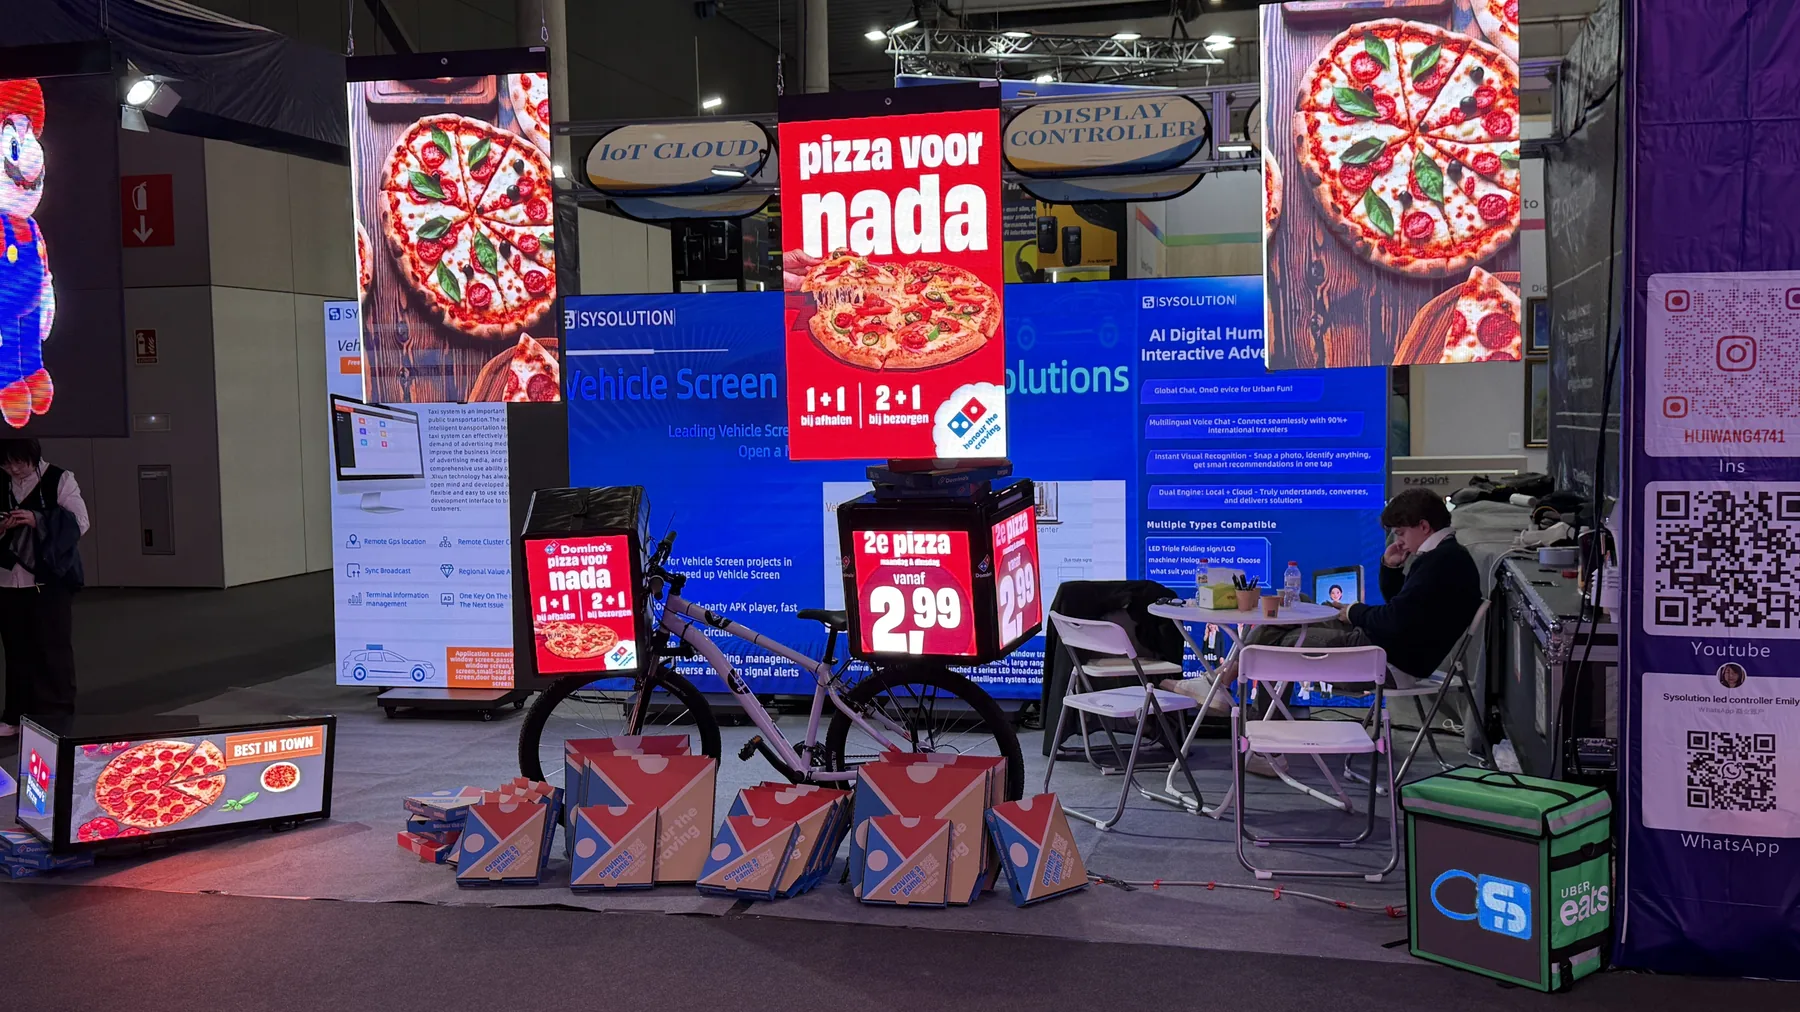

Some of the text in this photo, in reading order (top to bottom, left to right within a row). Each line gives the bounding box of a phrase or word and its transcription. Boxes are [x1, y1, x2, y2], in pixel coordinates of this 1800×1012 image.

[1041, 102, 1165, 124] DISPLAY
[1010, 119, 1196, 147] CONTROLLER
[654, 138, 760, 161] CLOUD
[800, 130, 982, 180] pizza voor
[1523, 198, 1539, 209] to
[800, 174, 989, 256] nada
[1159, 296, 1235, 307] SYSOLUTION
[581, 309, 673, 327] SYSOLUTION
[1149, 329, 1165, 342] AI
[1171, 328, 1221, 344] Digital
[1141, 347, 1224, 362] Interactive
[567, 367, 777, 401] Vehicle Screen
[1154, 387, 1177, 395] Global
[1178, 387, 1198, 395] Chat,
[1240, 385, 1251, 393] for
[800, 414, 852, 427] bij afhalen
[869, 413, 929, 425] bij bezorgen
[1149, 418, 1191, 427] Multilingual
[1237, 417, 1267, 425] Connect
[1268, 417, 1308, 426] seamlessly
[1310, 416, 1326, 424] with
[1327, 416, 1348, 424] 90%+
[668, 424, 761, 440] Leading Vehicle
[963, 412, 999, 450] honour the
[1208, 425, 1288, 434] international travelers
[1684, 429, 1785, 443] HUIWANG4741
[975, 424, 1001, 450] craving
[738, 445, 770, 459] Open
[1155, 451, 1371, 461] Instant Visual Recognition Snap photo, identify anything,
[1193, 461, 1205, 469] get
[1206, 460, 1227, 468] smart
[1229, 460, 1294, 468] recommendations
[1319, 460, 1333, 469] tap
[1719, 459, 1745, 473] Ins
[1177, 489, 1204, 497] Engine:
[1259, 488, 1278, 497] Truly
[1279, 488, 1328, 497] understands,
[1329, 489, 1368, 497] converses,
[994, 523, 1007, 547] 2e
[1007, 511, 1029, 540] pizza
[1147, 520, 1277, 531] Multiple Types Compatible
[561, 543, 612, 554] Domino's
[864, 531, 951, 557] 2e pizza
[1161, 545, 1180, 554] Triple
[1181, 545, 1205, 553] Folding
[1206, 545, 1236, 553] sign/LCD
[547, 554, 608, 569] pizza voor
[667, 557, 781, 567] for Vehicle Screen projects
[365, 567, 379, 575] Sync
[703, 570, 780, 580] up Vehicle Screen
[549, 566, 611, 591] nada
[893, 572, 926, 586] vanaf
[730, 602, 798, 613] APK player, fast
[1691, 642, 1771, 658] Youtube
[744, 667, 799, 677] signal alerts
[971, 675, 1027, 684] intelligent system
[1663, 693, 1800, 707] Sysolution led controller Emily
[234, 736, 314, 758] BEST IN TOWN
[1681, 833, 1780, 857] WhatsApp
[484, 849, 512, 873] craving
[599, 853, 624, 879] craving
[890, 869, 917, 895] craving
[1561, 881, 1590, 898] UBER
[1560, 885, 1609, 926] eats
